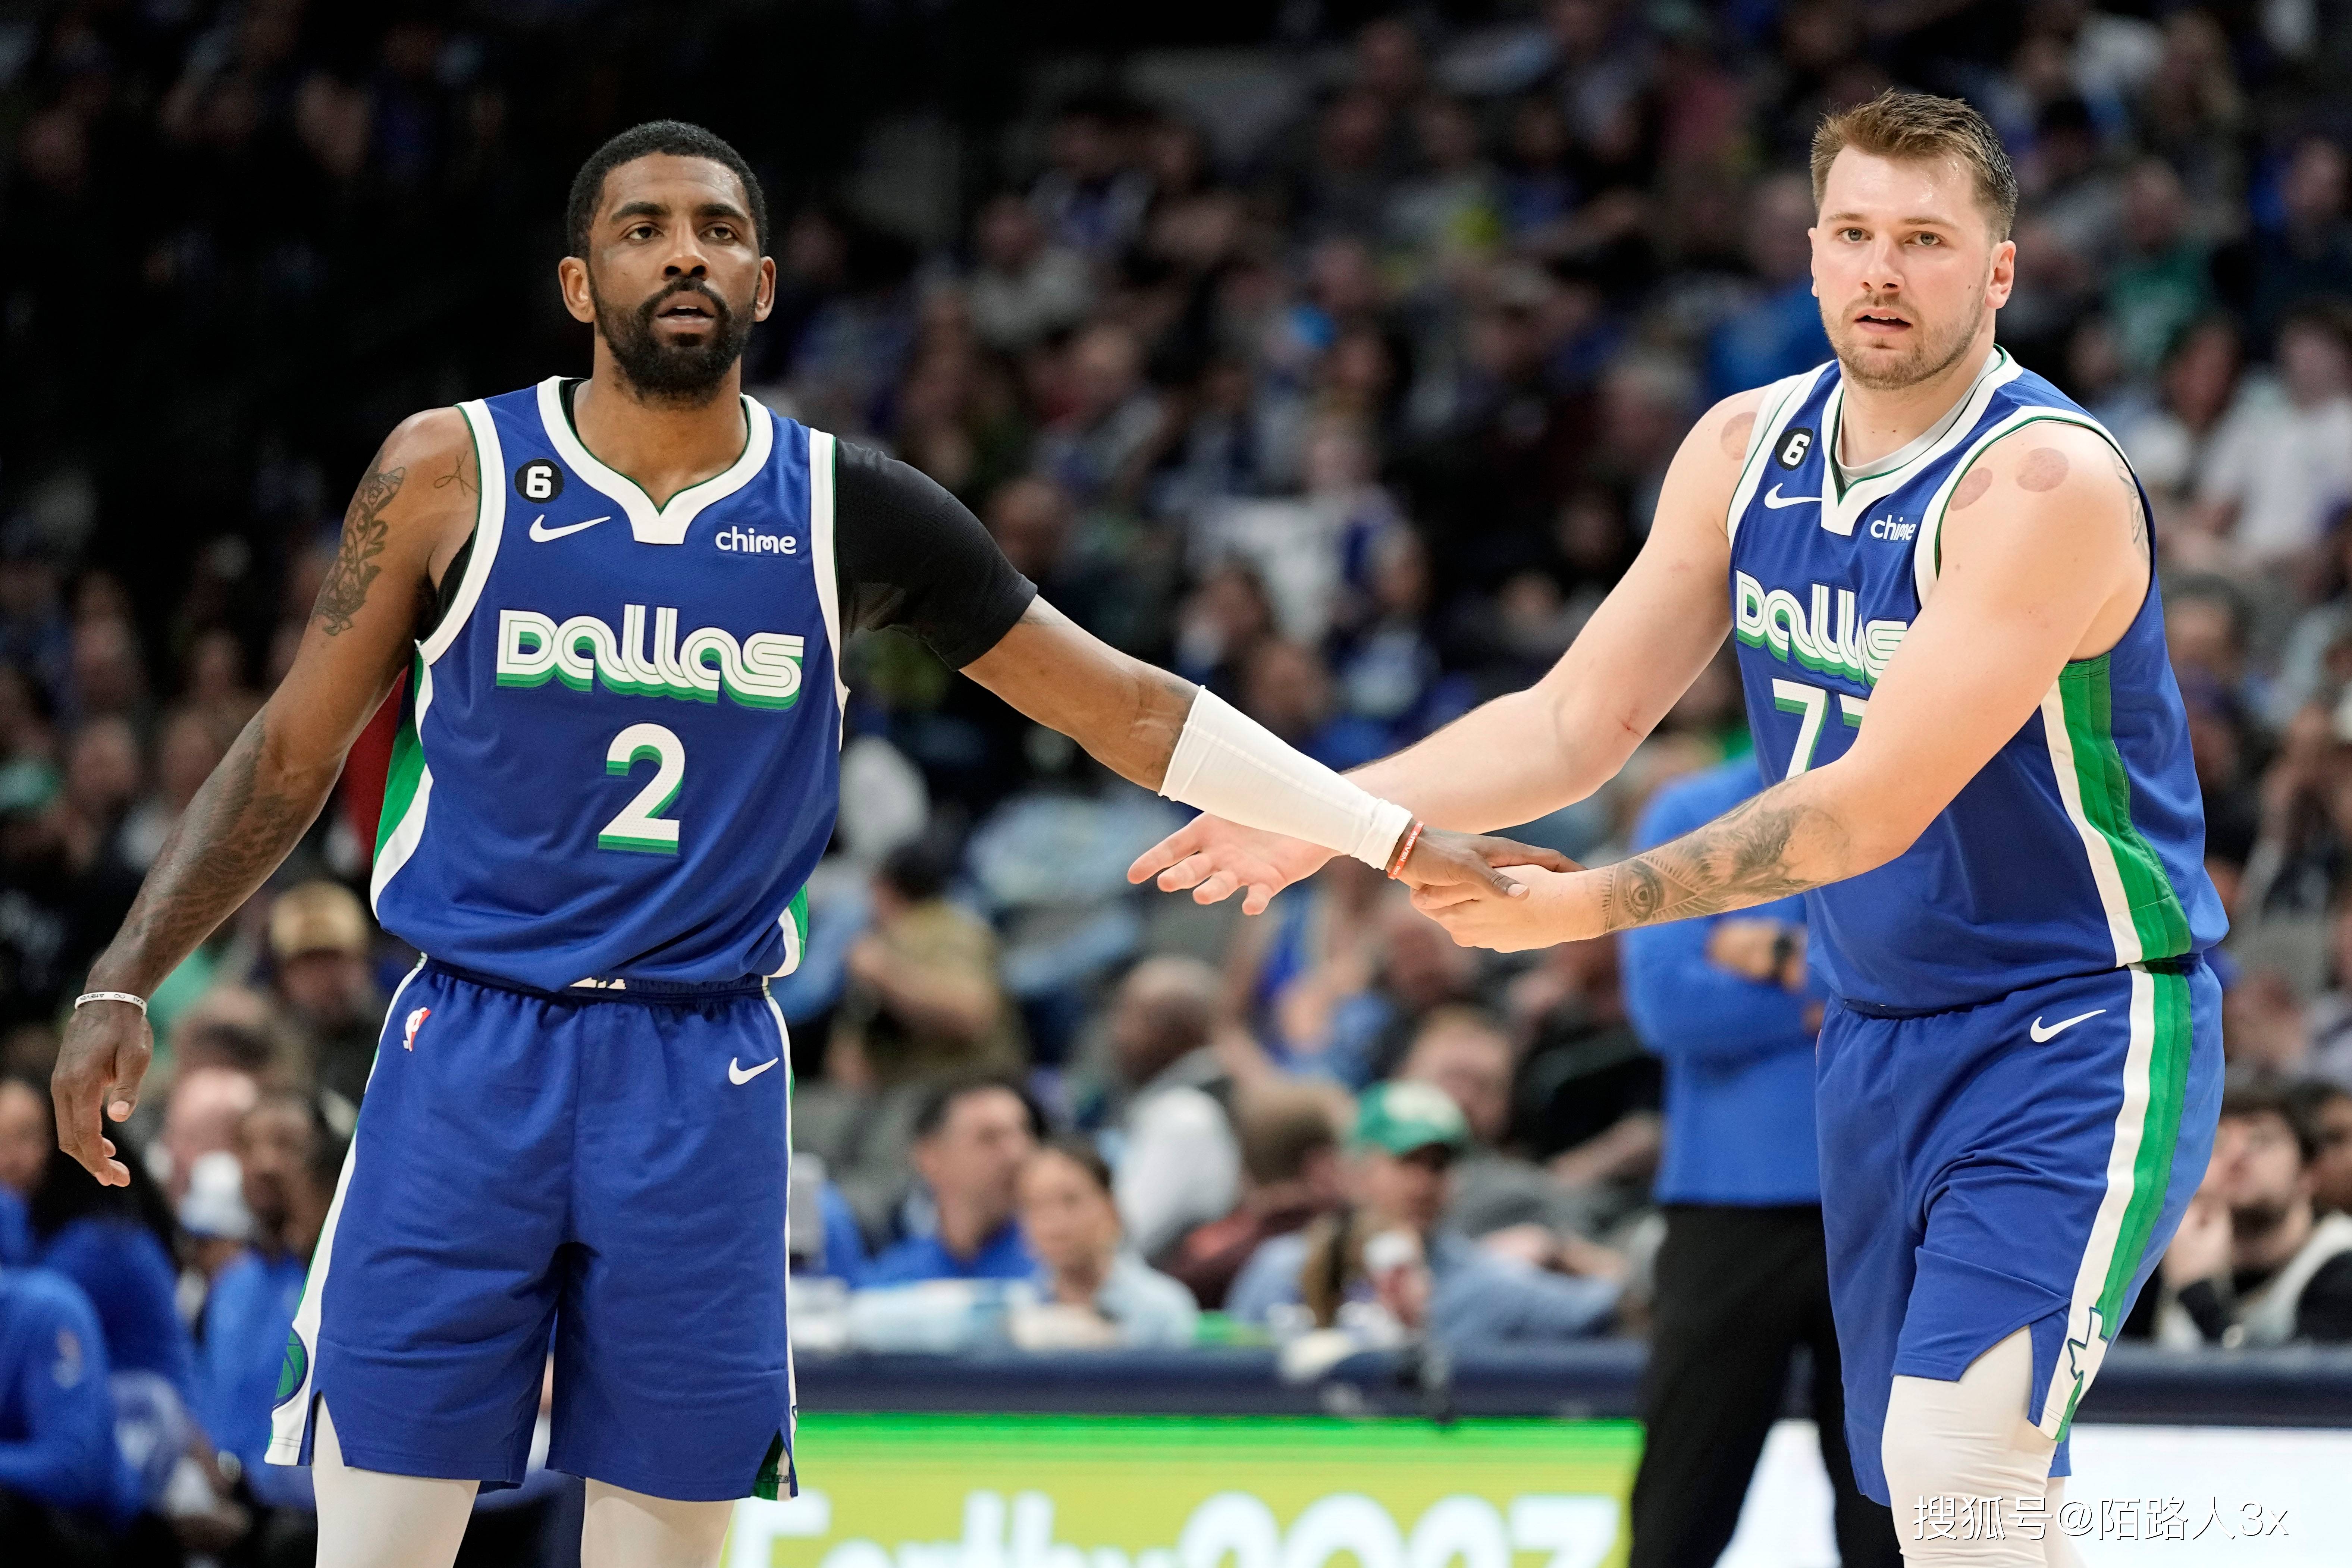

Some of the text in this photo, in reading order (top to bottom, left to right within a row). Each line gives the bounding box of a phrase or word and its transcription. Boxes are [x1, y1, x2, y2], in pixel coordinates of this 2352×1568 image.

[526, 465, 552, 498] 6
[1782, 433, 1810, 465] 6
[716, 526, 796, 555] chime
[1870, 515, 1916, 540] chime
[496, 604, 804, 710] Dallas
[1736, 570, 1907, 688] Dalls
[1772, 678, 1868, 781] 7
[598, 722, 685, 854] 2
